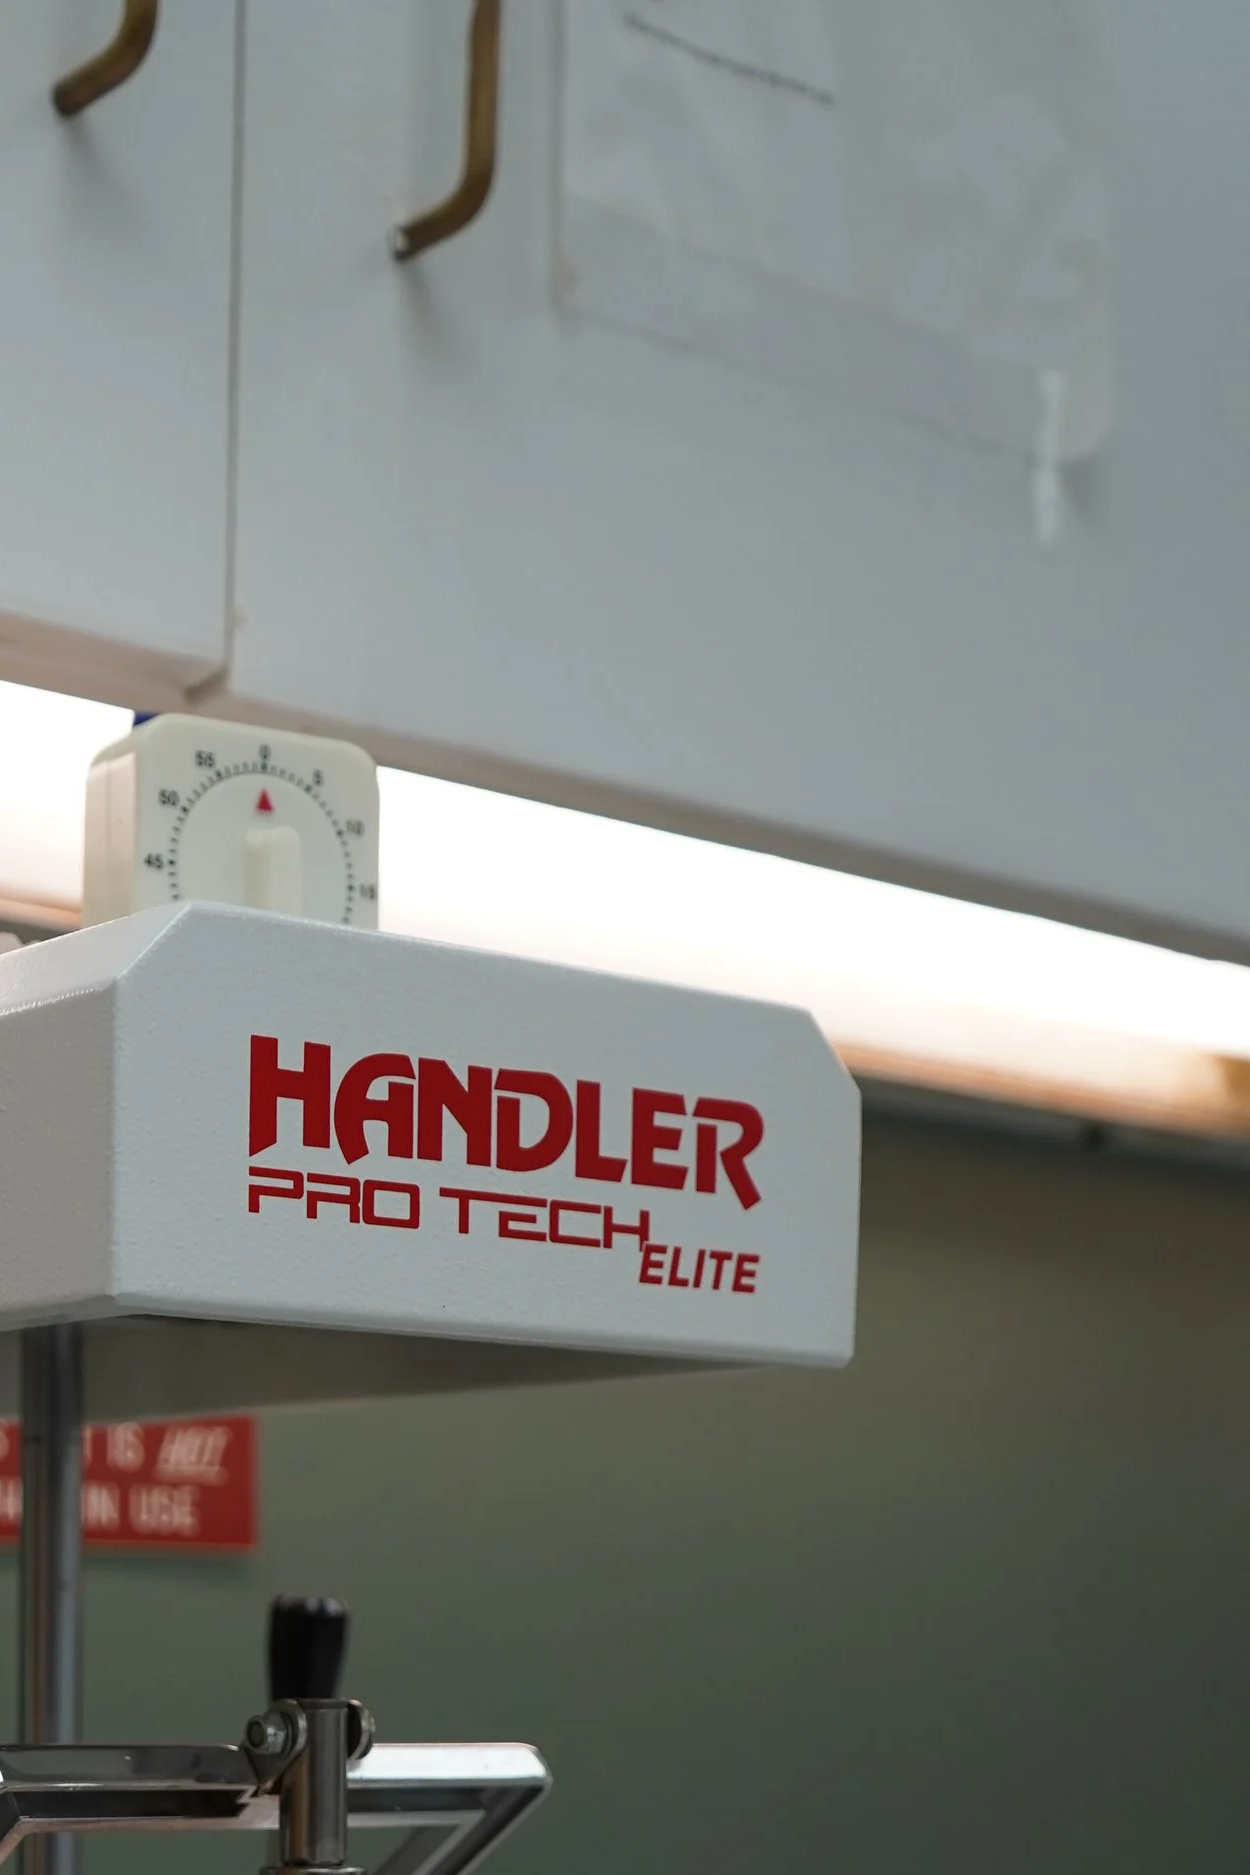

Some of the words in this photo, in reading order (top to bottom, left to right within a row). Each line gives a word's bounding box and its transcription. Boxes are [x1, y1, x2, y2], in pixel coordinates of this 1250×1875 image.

[195, 750, 217, 770] 55
[258, 744, 271, 760] 0
[311, 769, 324, 788] 5
[158, 788, 180, 807] 50
[346, 819, 365, 837] 10
[143, 852, 164, 871] 45
[359, 884, 377, 901] 15
[249, 1034, 765, 1211] HANDLER
[248, 1166, 420, 1230] PRO
[439, 1187, 650, 1252] TECH
[638, 1243, 761, 1294] ELITE
[106, 1421, 145, 1472] IS
[128, 1484, 201, 1536] USE
